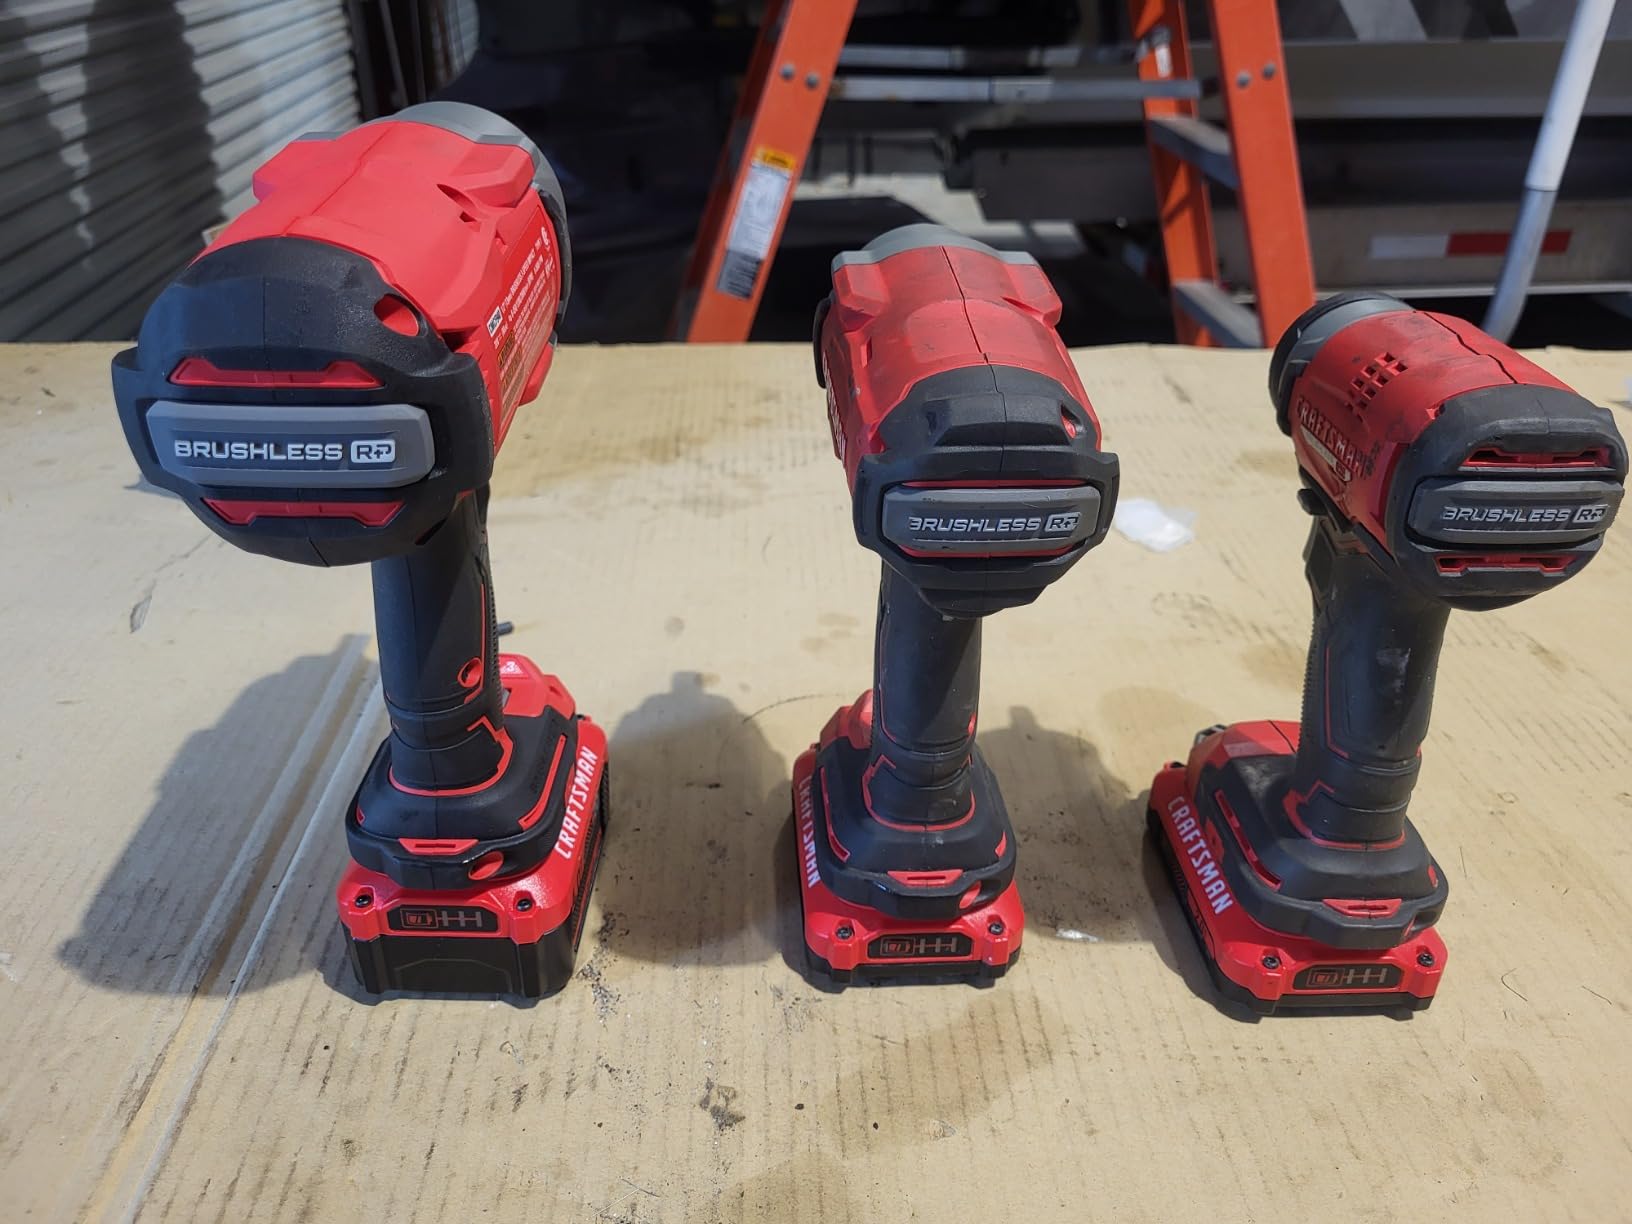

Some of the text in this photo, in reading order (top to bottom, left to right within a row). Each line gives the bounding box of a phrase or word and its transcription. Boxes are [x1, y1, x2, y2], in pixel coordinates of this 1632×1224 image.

[174, 440, 343, 461] BRUSHLESS
[908, 516, 1041, 533] BRUSHLESS
[1443, 507, 1572, 523] BRUSHLESS
[555, 746, 598, 859] CRAFTSMAN
[1168, 796, 1233, 914] CRAFTSMAN
